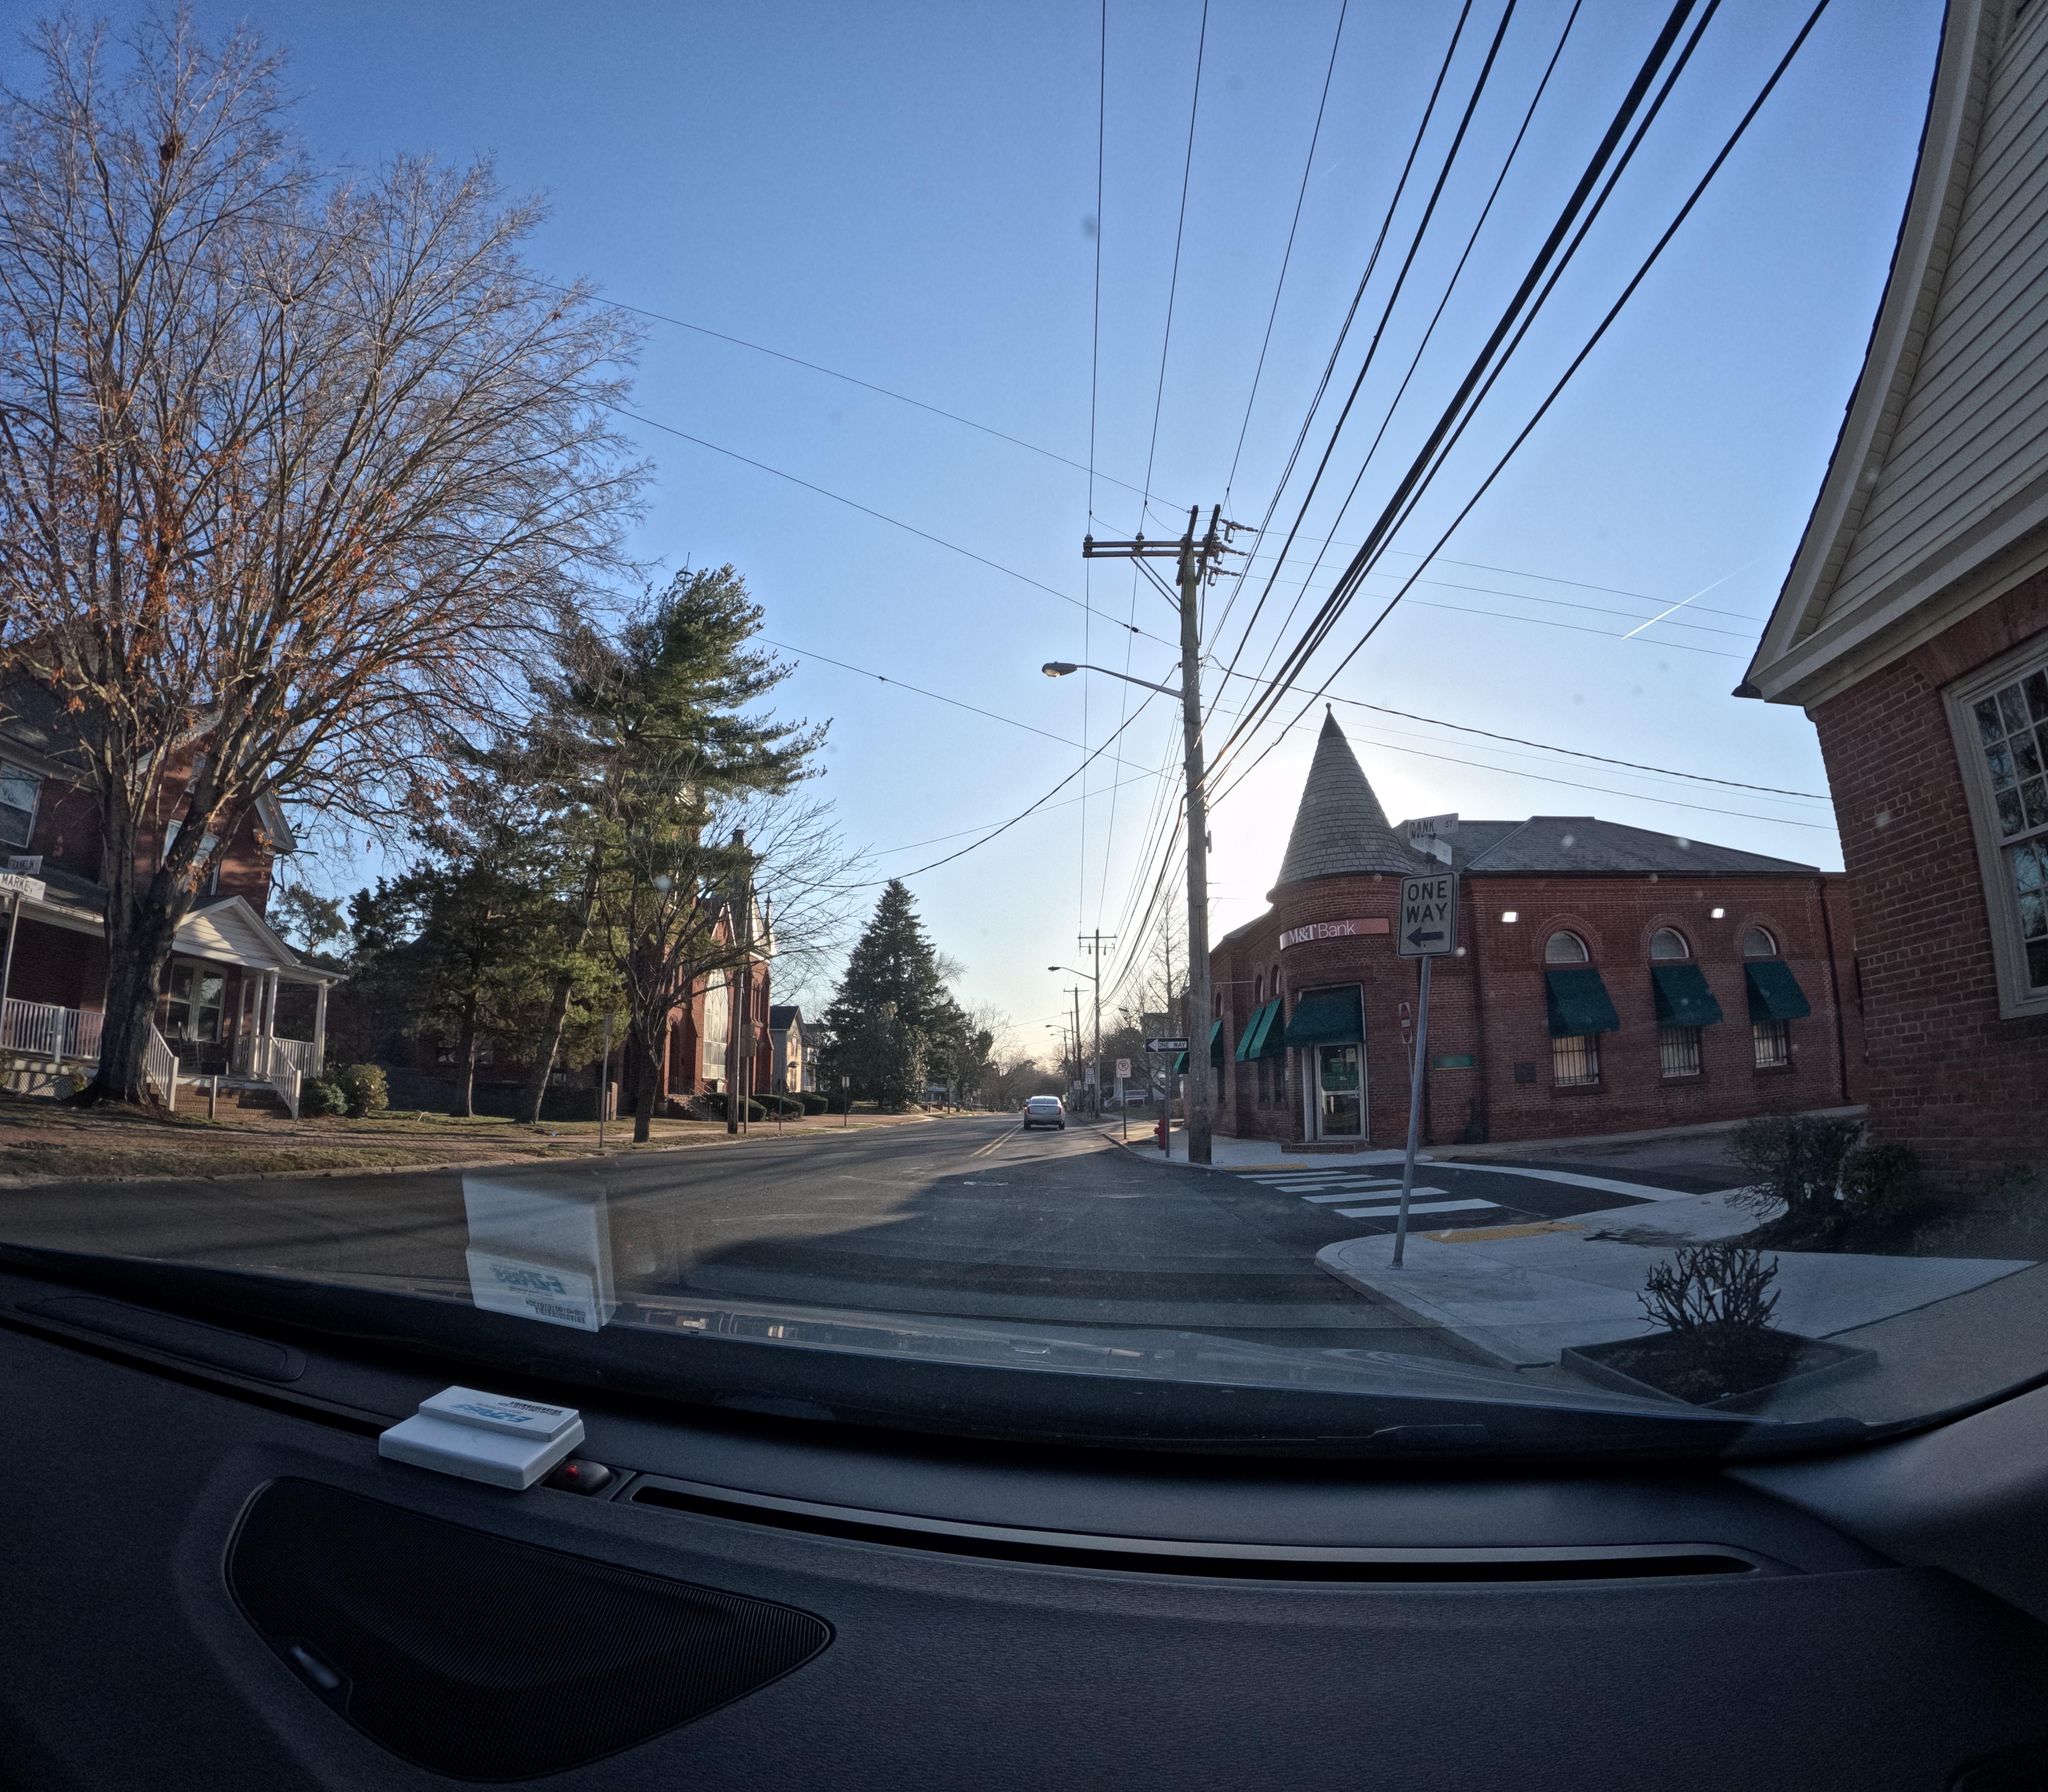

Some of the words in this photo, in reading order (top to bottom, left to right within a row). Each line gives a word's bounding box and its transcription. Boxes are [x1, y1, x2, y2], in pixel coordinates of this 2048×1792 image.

[2, 873, 33, 895] MARKE
[1407, 880, 1448, 901] ONE
[1406, 902, 1448, 924] WAY
[1288, 923, 1317, 945] M&T
[1317, 919, 1357, 939] Bank
